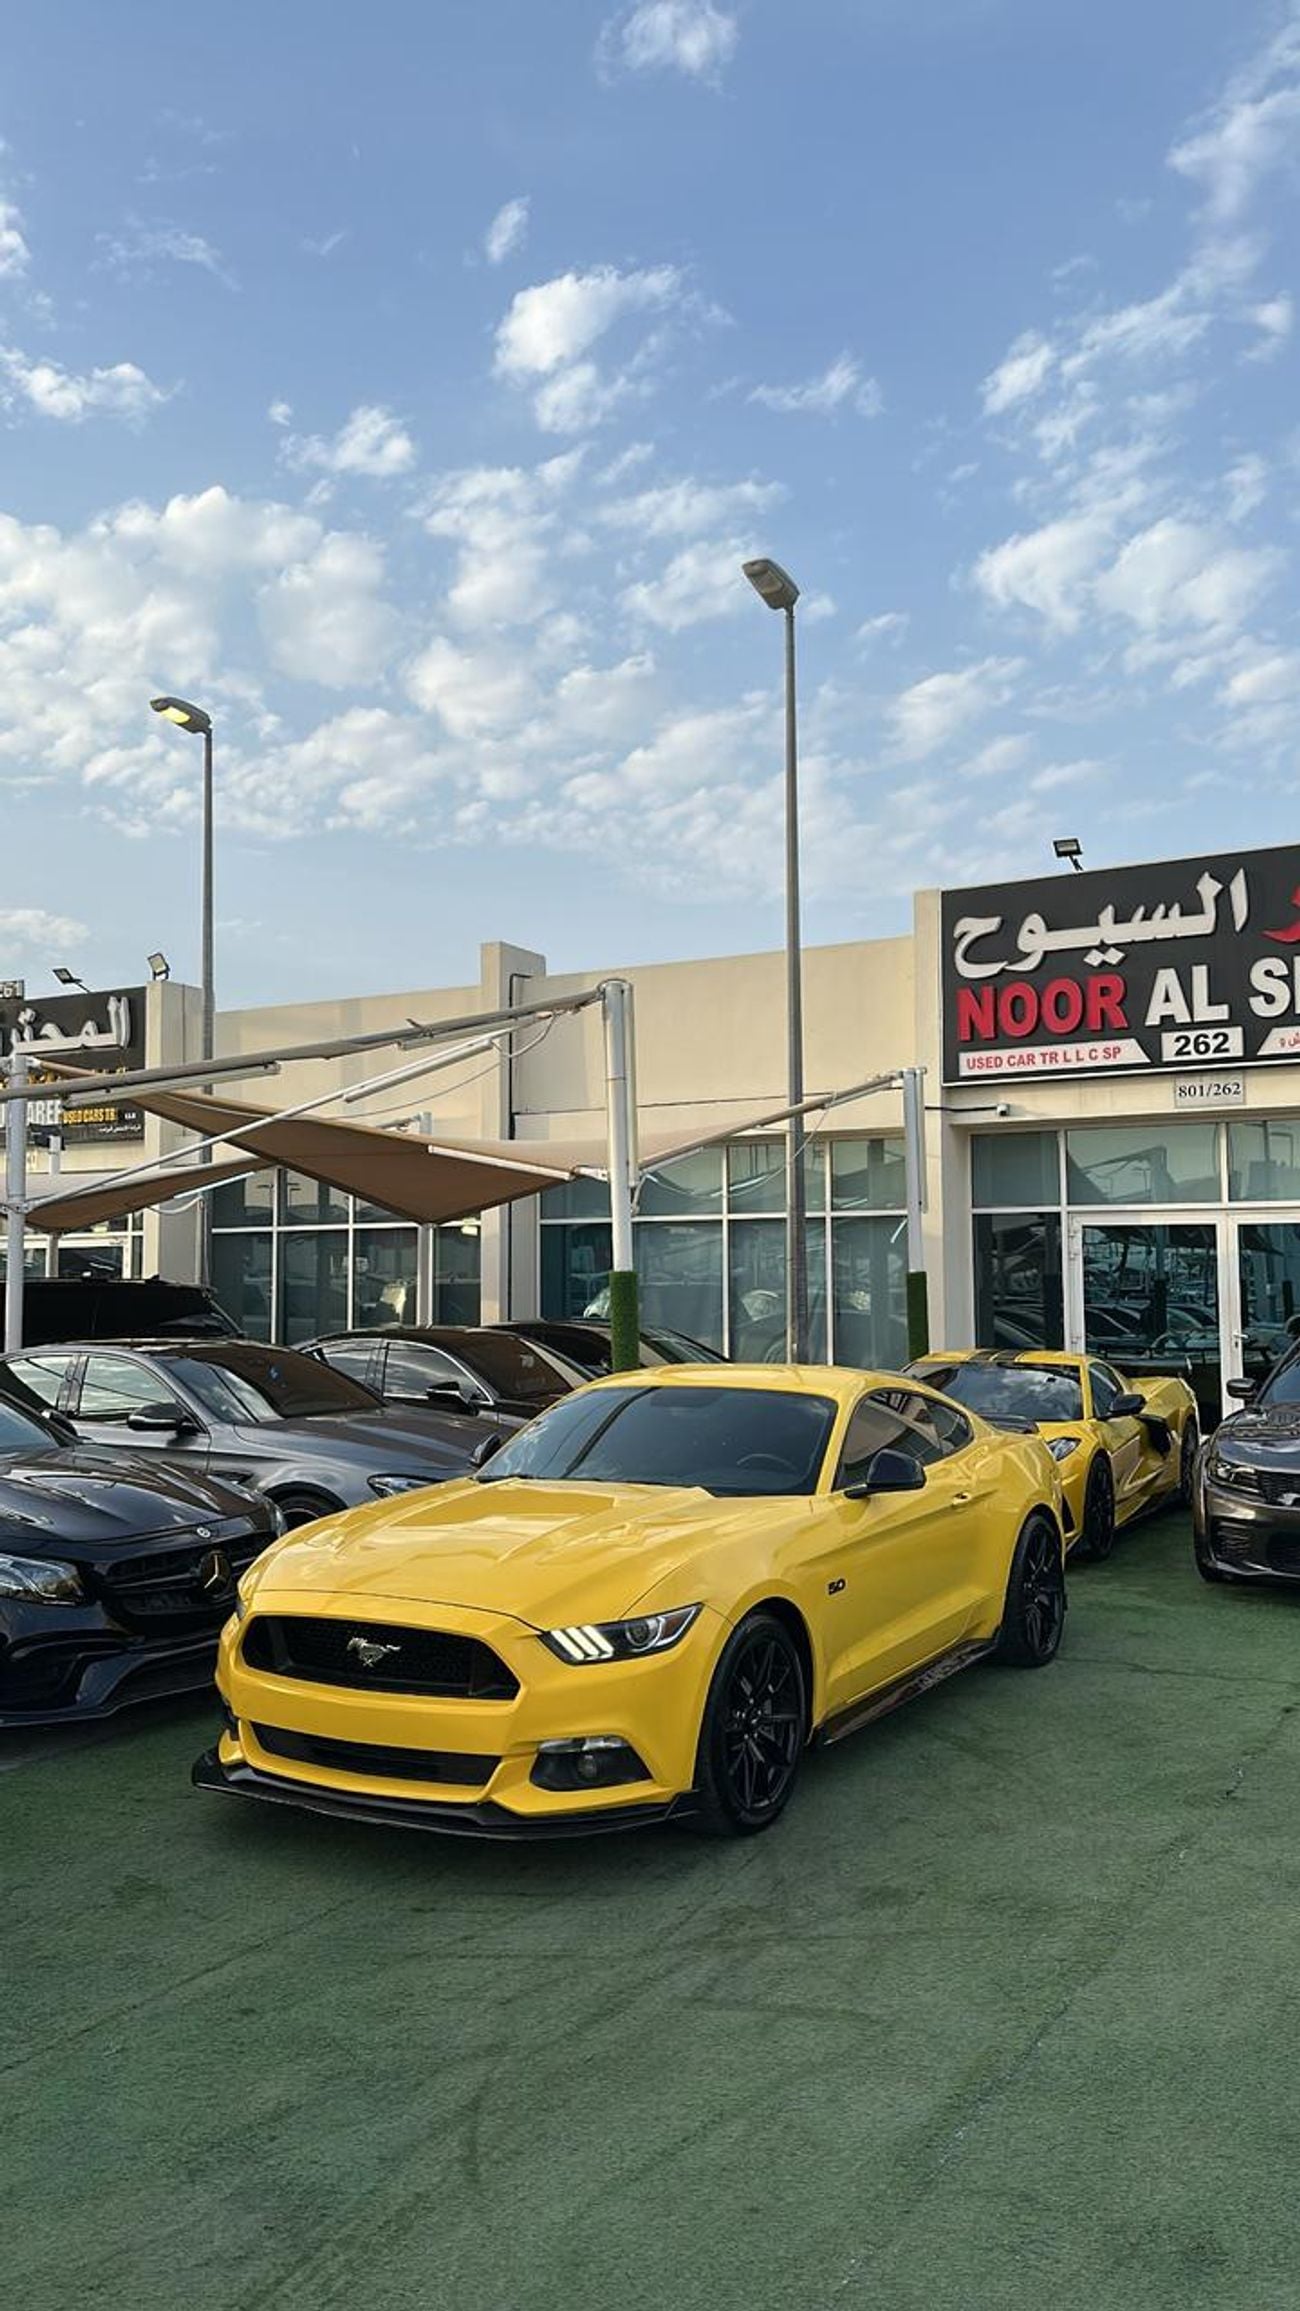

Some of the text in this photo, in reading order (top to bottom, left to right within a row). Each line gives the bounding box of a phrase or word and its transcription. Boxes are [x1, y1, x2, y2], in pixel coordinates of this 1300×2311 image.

[953, 868, 1249, 979] السيوح
[957, 974, 1128, 1041] NOOR
[1144, 964, 1229, 1026] AL
[1174, 1032, 1230, 1056] 262
[966, 1046, 1121, 1070] USED CAR TR L L C SP
[1178, 1082, 1241, 1098] 801/262
